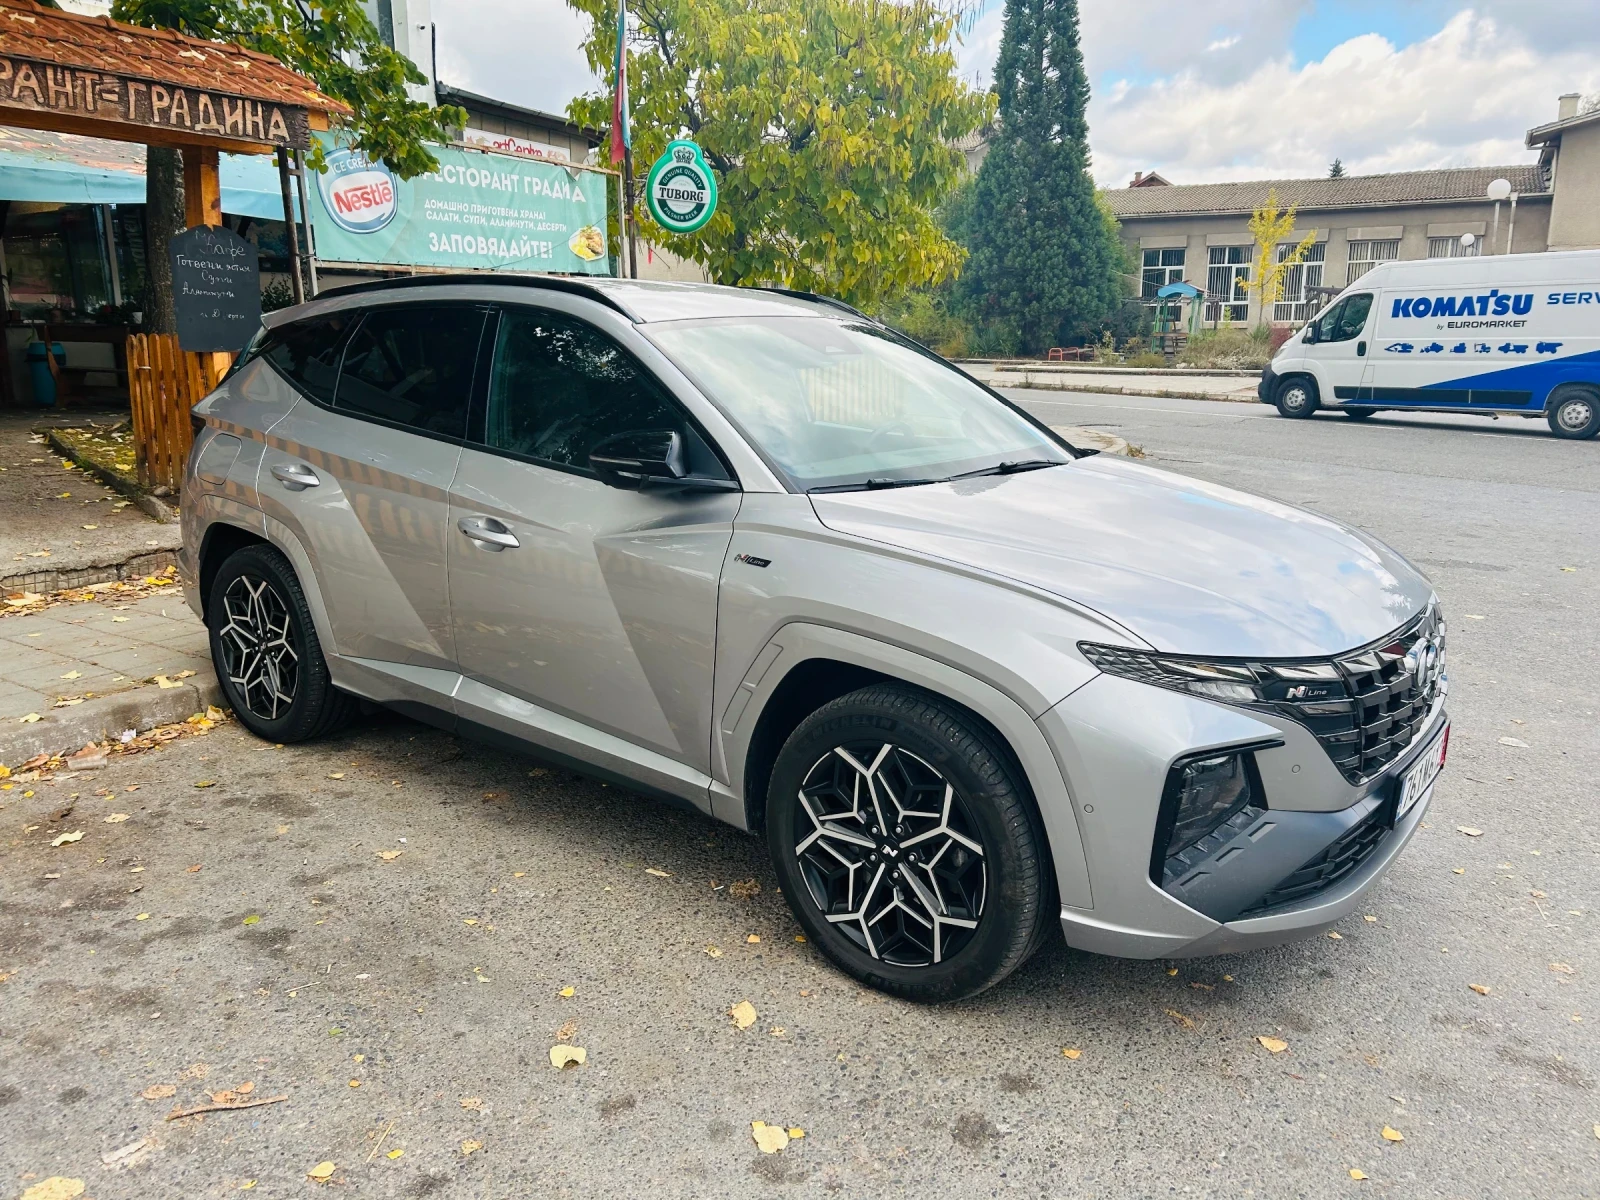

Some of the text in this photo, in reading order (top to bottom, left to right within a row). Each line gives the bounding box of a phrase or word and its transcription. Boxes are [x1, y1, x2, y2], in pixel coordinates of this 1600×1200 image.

[331, 160, 347, 175] ICE
[662, 168, 703, 187] GENUINE QUALITY
[523, 176, 587, 203] ГРАДИА
[659, 187, 704, 202] TUBORG
[424, 199, 546, 220] ДОМАШНО ПРИГОТВЕНА ХРАНА!
[663, 207, 698, 221] PILSNER BEER
[426, 211, 462, 223] САЛАТИ,
[463, 215, 488, 226] СУПИ,
[537, 222, 567, 232] ДЕСЕРТИ
[428, 232, 553, 259] ЗАПОВЯДАЙТЕ!
[1391, 289, 1534, 319] KOMATSU
[1447, 320, 1528, 329] EUROMARKET
[811, 714, 894, 740] MICHELIN
